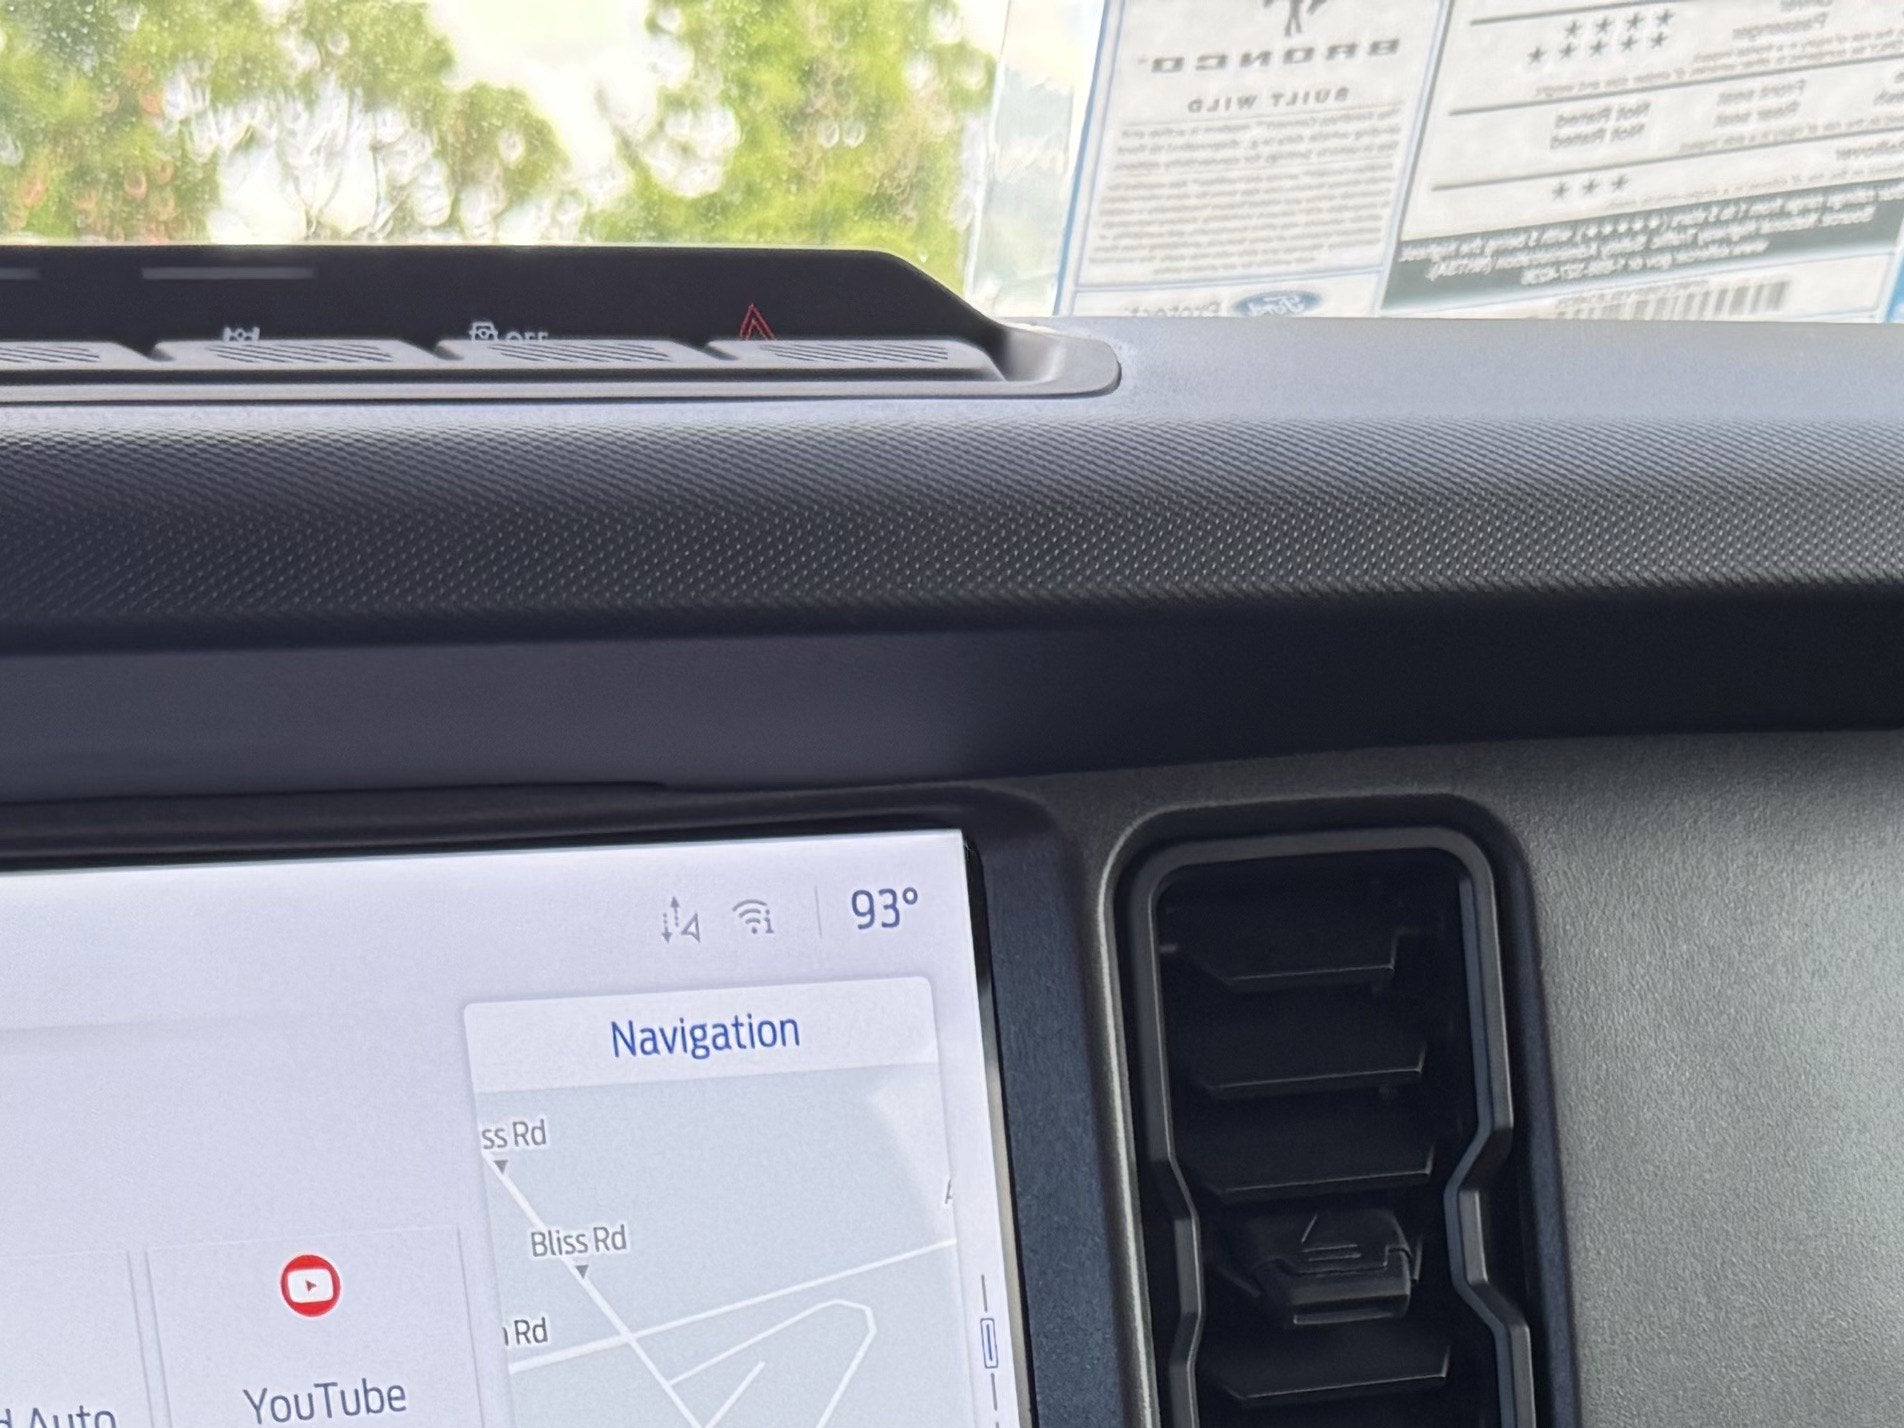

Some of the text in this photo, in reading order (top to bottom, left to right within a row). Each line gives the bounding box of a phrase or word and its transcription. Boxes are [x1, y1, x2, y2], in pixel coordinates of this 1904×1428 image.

[850, 886, 919, 932] 93°
[610, 1012, 801, 1062] Navigation
[512, 1119, 547, 1148] Rd
[530, 1223, 628, 1258] Bliss Rd
[513, 1316, 549, 1346] Rd
[243, 1378, 408, 1428] YouTube
